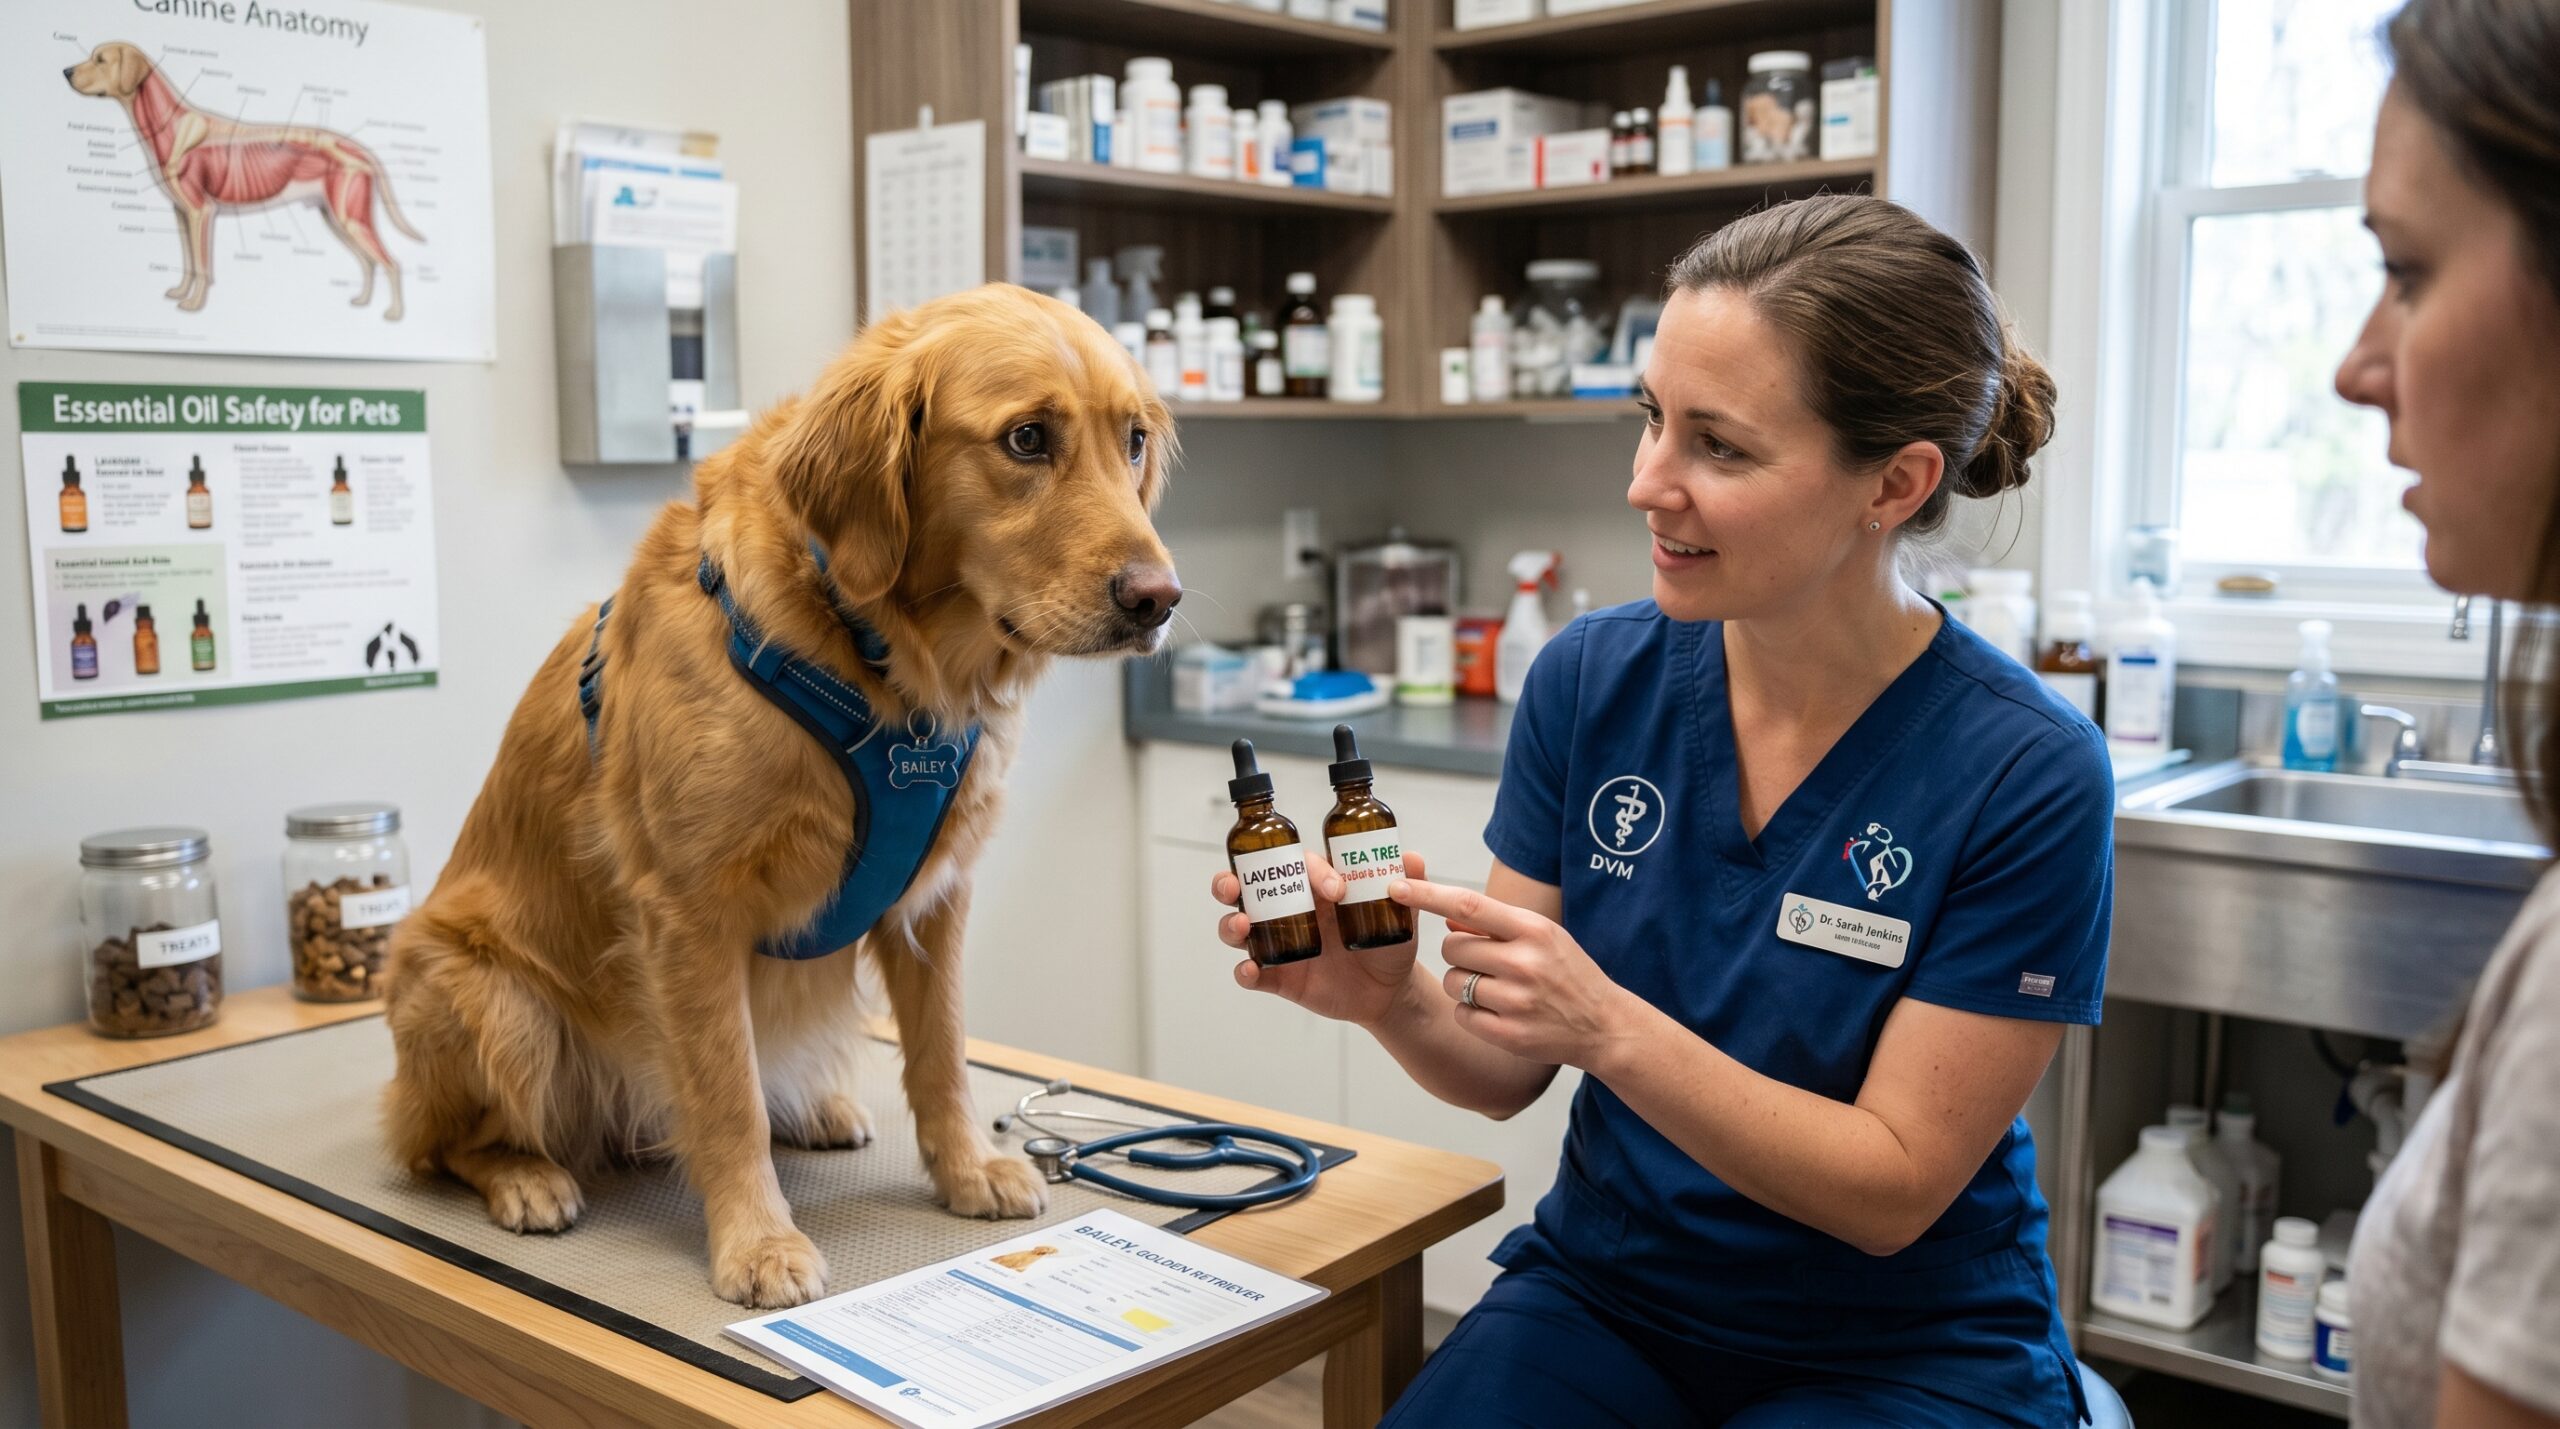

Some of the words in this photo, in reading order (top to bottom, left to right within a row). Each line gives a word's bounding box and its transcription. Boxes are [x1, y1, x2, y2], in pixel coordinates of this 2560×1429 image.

[245, 3, 369, 47] Anatomy
[52, 393, 176, 424] Essential
[181, 394, 219, 425] Oil
[224, 394, 305, 431] Safety
[309, 395, 345, 425] for
[350, 398, 401, 426] Pets
[902, 761, 946, 774] BAILEY
[1341, 851, 1370, 867] TEA
[1371, 844, 1401, 862] TREE
[1589, 853, 1635, 881] DVM
[1376, 866, 1388, 877] to
[1256, 886, 1278, 902] (Pet
[1820, 913, 1834, 926] Dr.
[1836, 918, 1864, 934] Sarah
[1866, 926, 1904, 944] Jenkins
[1074, 1225, 1138, 1254] BAILEY,
[1136, 1248, 1193, 1275] GOLDEN
[1189, 1270, 1266, 1302] RETRIEVER
